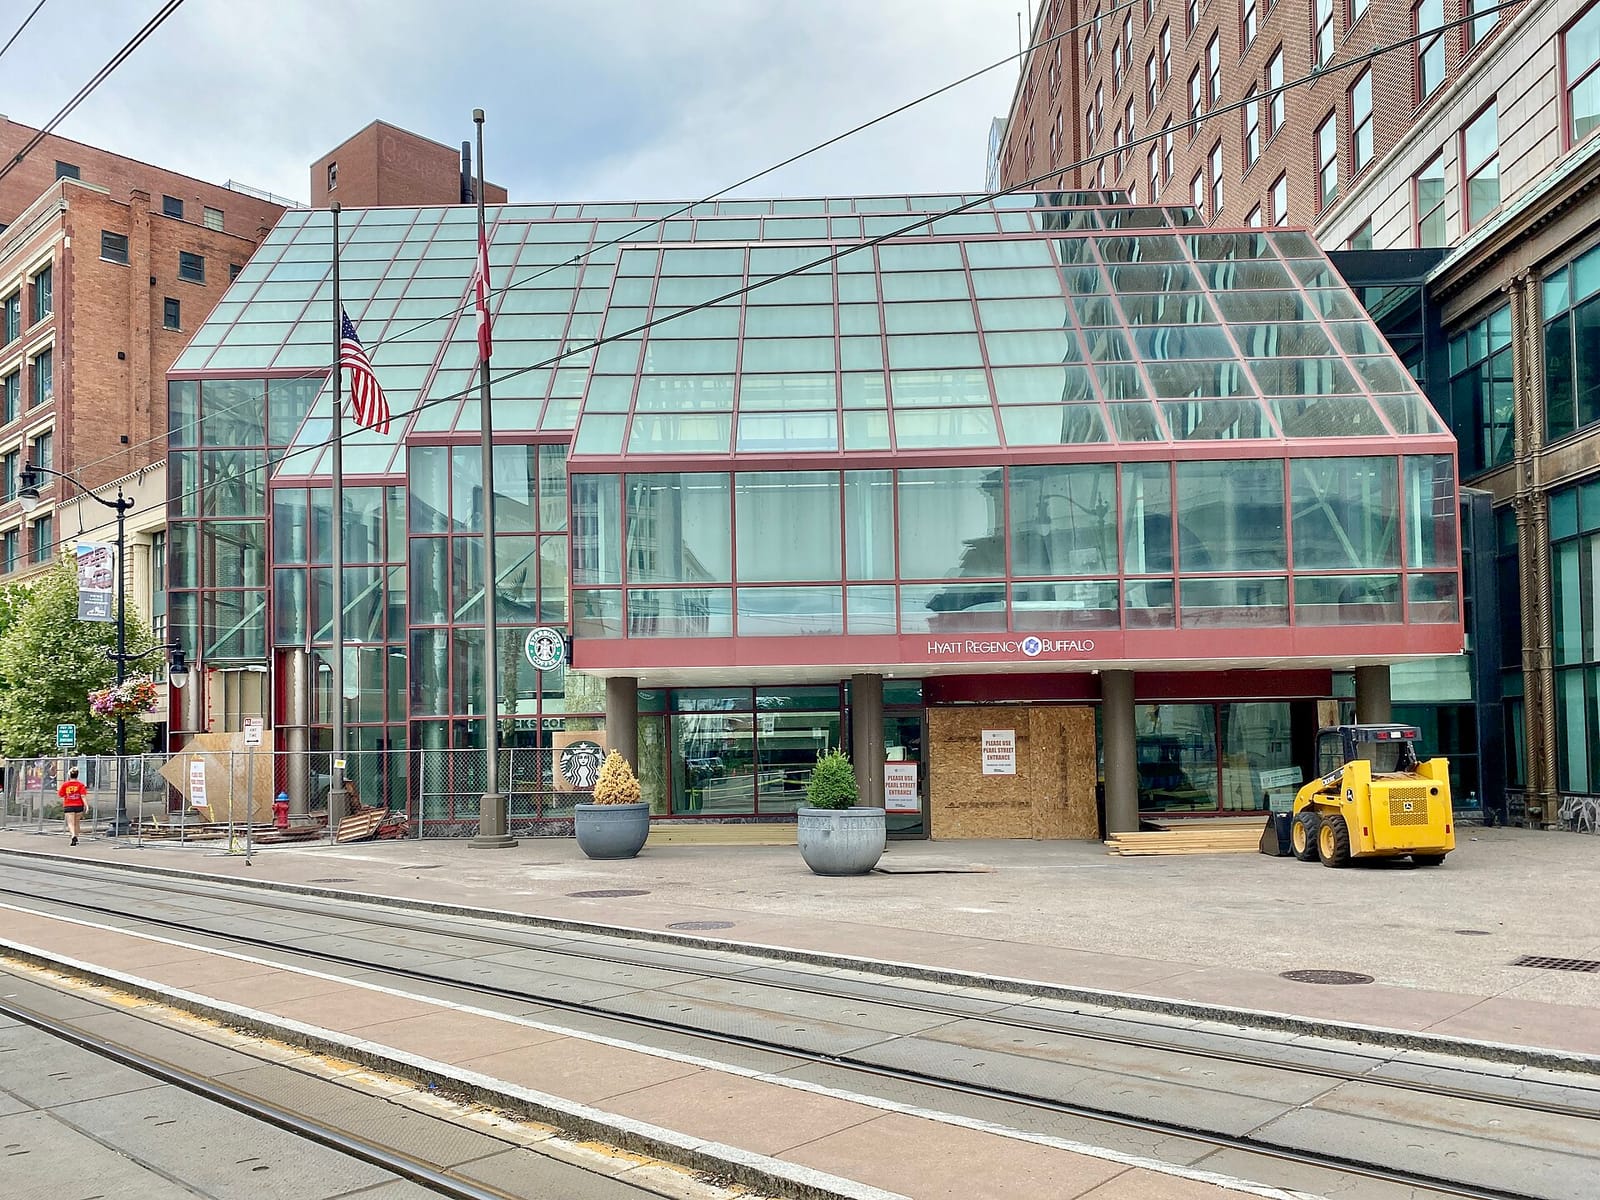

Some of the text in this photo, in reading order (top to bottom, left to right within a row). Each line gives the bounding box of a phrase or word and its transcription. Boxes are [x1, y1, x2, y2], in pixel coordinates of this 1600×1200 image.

[530, 631, 561, 647] STARBUCKS
[928, 638, 1095, 654] HYATT REGENCY BUFFALO
